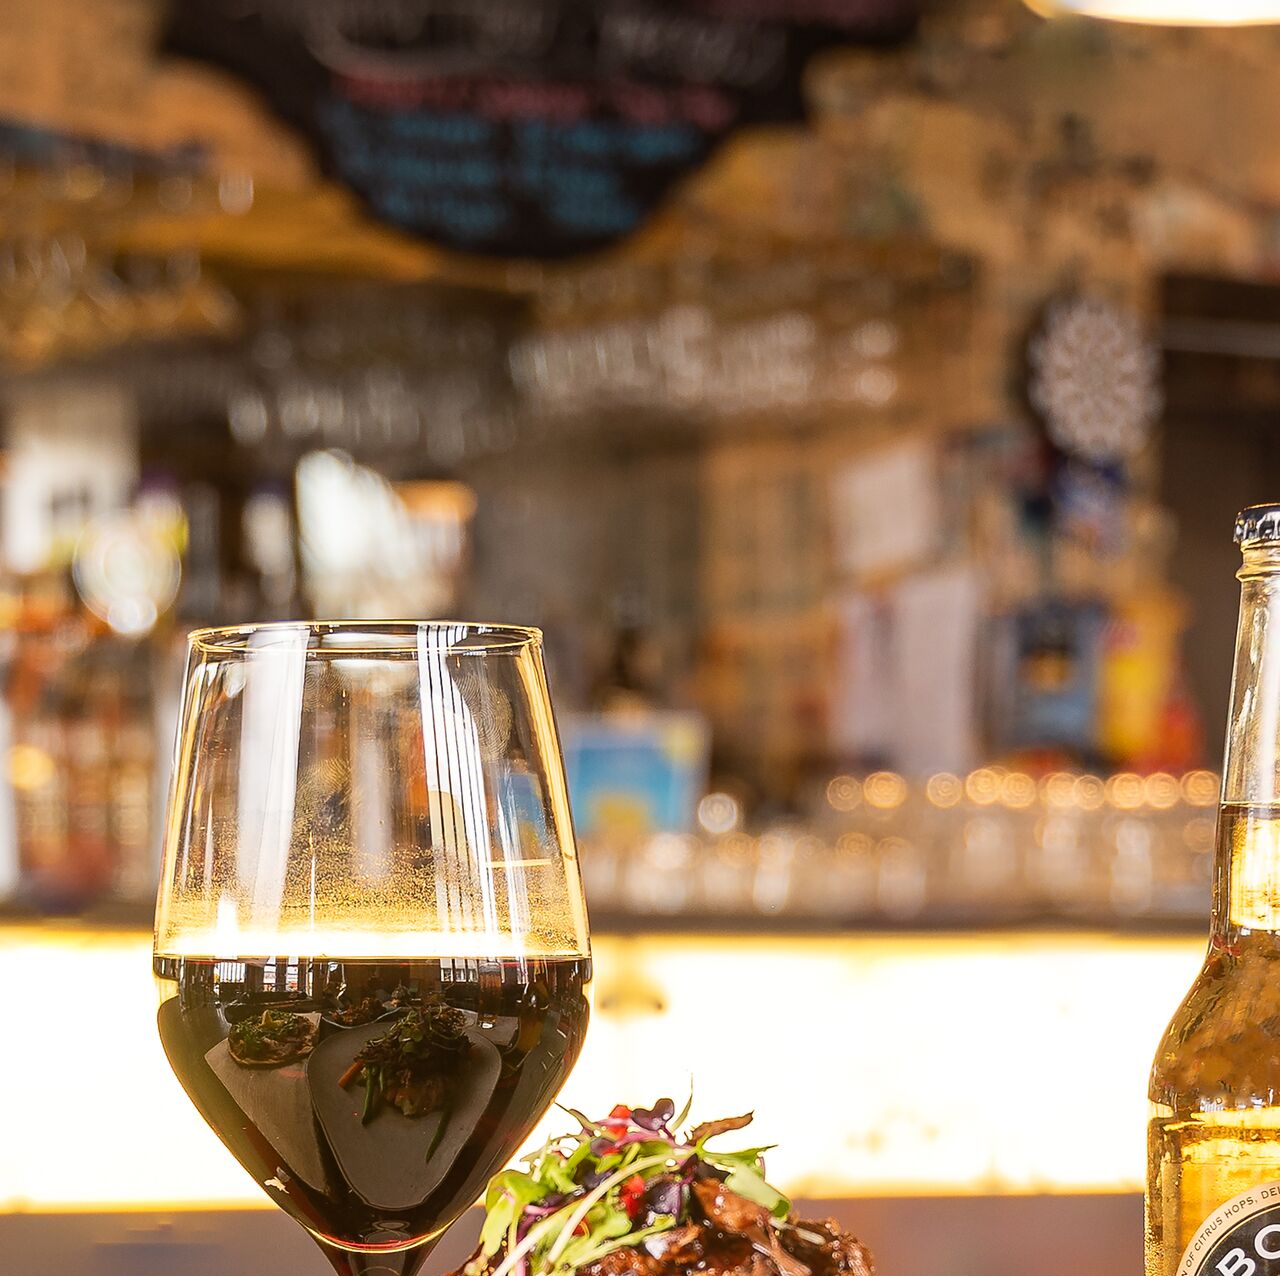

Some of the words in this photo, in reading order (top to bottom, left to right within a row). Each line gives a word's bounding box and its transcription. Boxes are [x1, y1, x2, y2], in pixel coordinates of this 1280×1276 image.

[1186, 1253, 1196, 1267] OF
[1194, 1216, 1224, 1252] CITRUS
[1224, 1196, 1258, 1219] HOPS,
